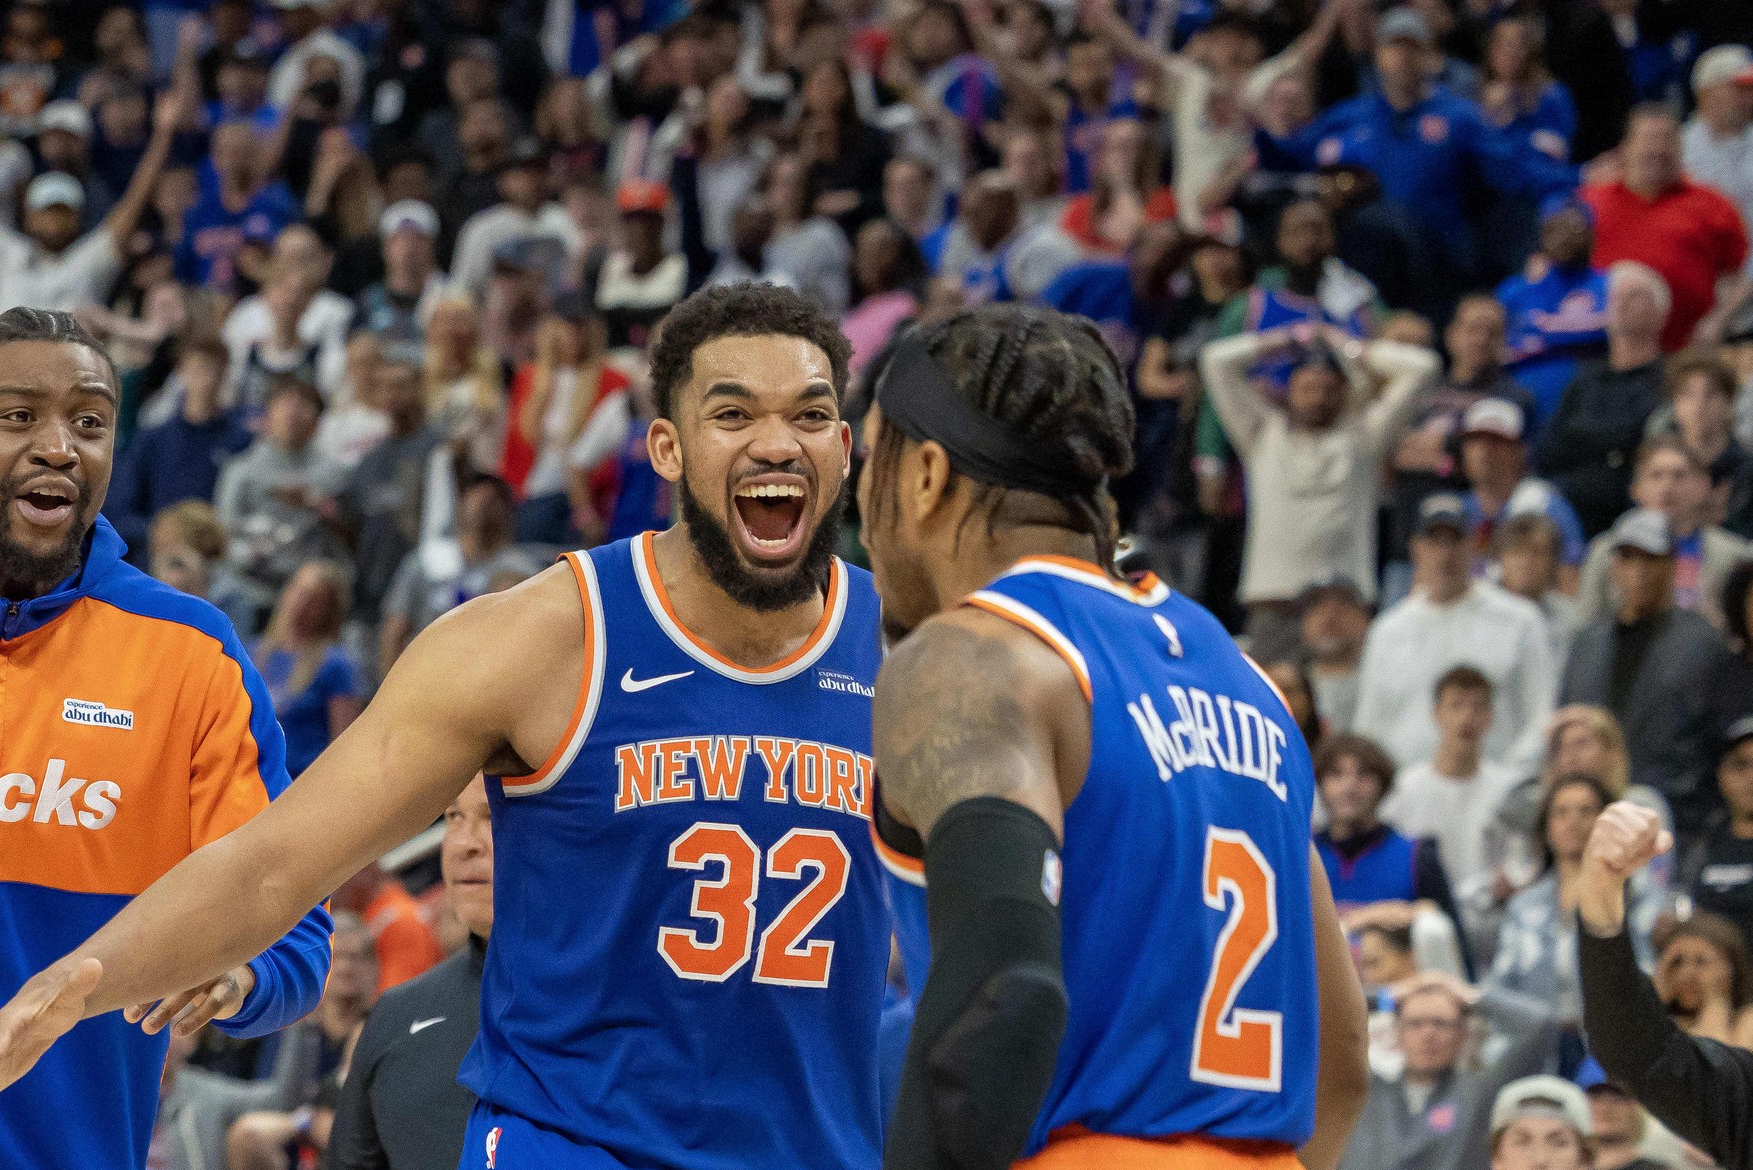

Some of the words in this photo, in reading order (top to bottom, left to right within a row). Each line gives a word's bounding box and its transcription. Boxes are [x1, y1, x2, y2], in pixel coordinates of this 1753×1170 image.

[65, 708, 91, 723] abu
[93, 711, 133, 728] dhabi
[819, 678, 845, 692] abu
[615, 735, 752, 814] NEW
[657, 821, 852, 988] 32
[1189, 823, 1284, 1093] 2
